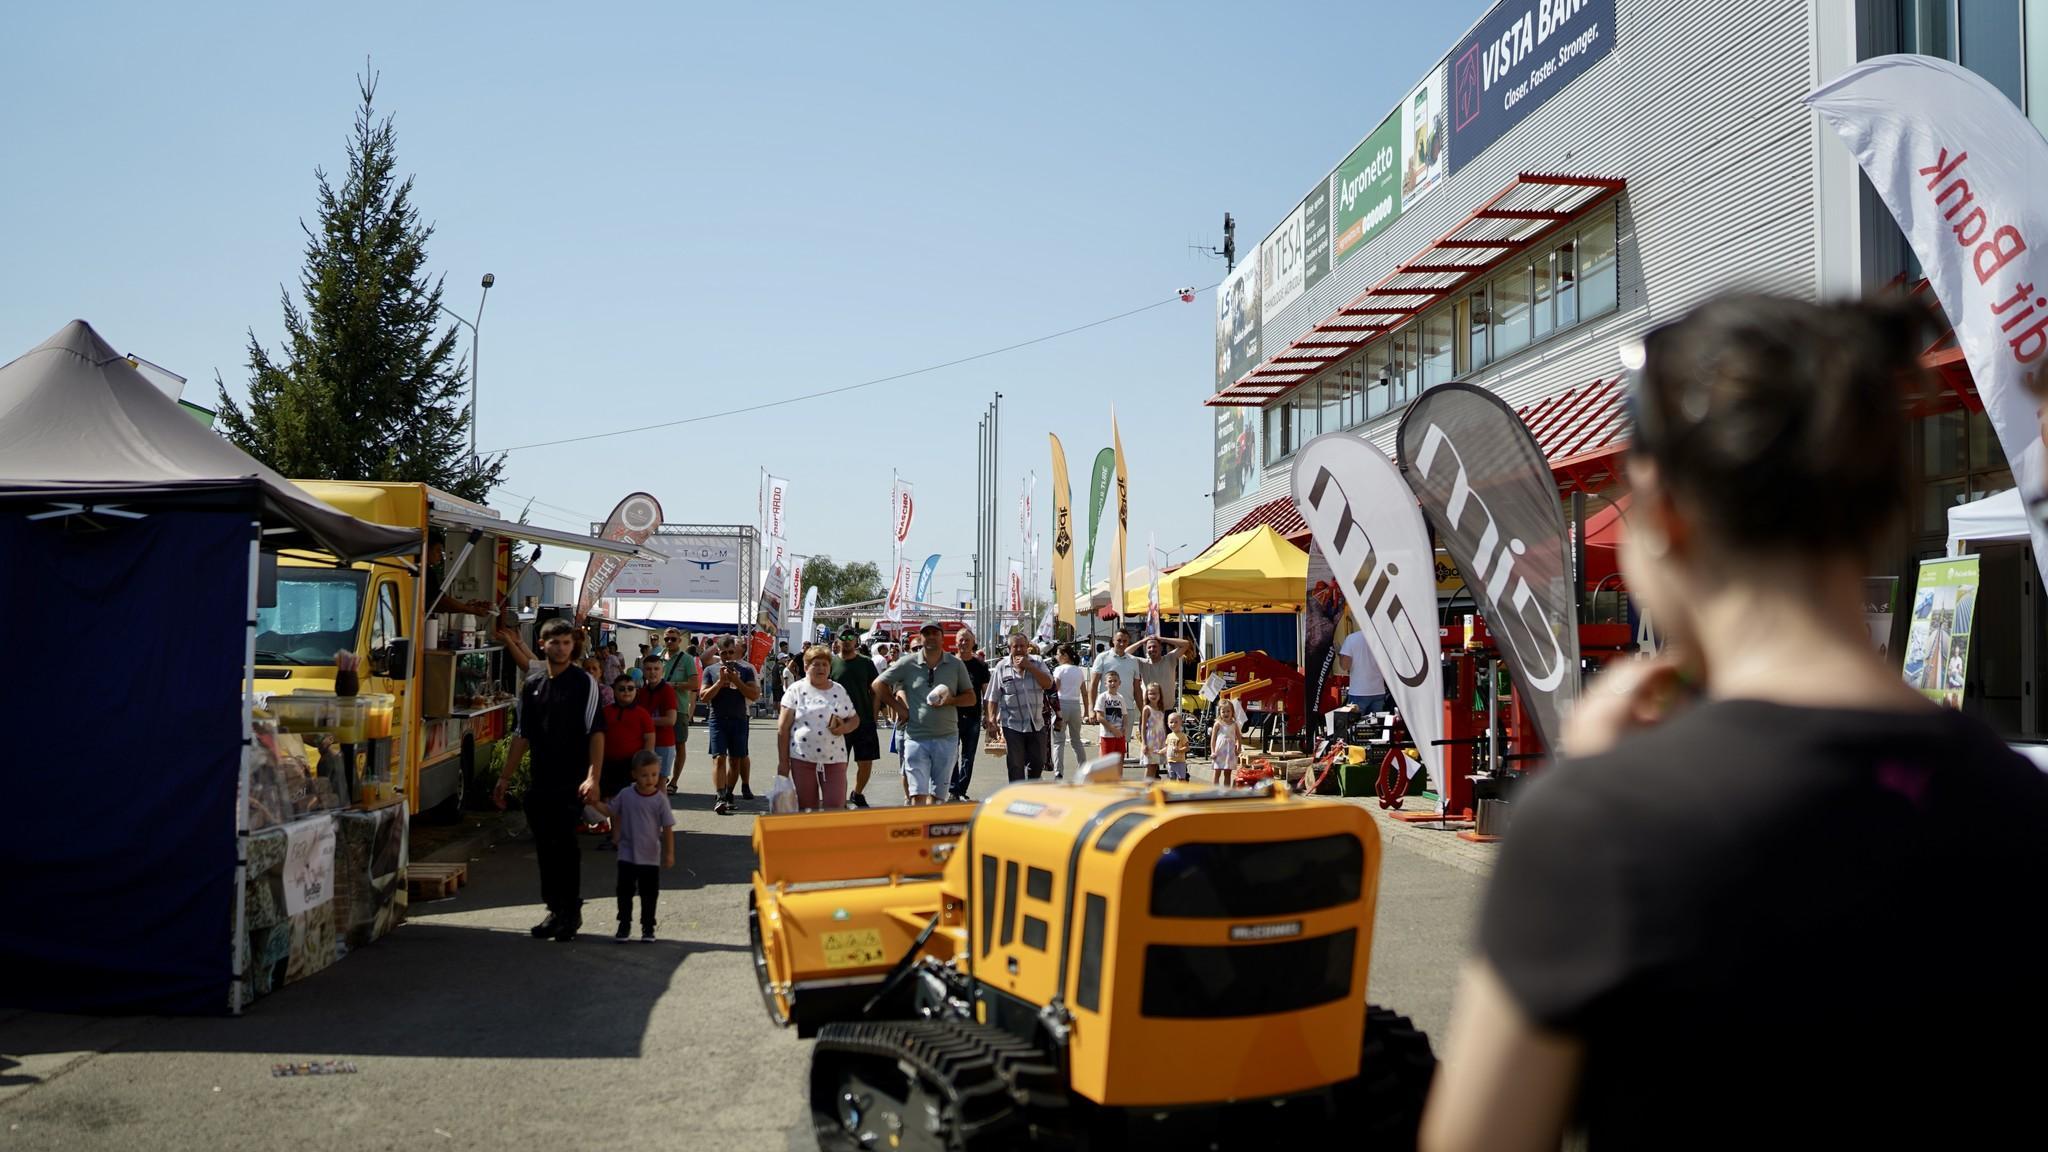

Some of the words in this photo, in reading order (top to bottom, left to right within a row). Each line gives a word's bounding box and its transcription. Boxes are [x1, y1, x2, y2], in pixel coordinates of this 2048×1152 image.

[1482, 10, 1533, 91] VISTA
[1504, 80, 1529, 111] Closer.
[1530, 57, 1557, 90] Faster.
[1558, 23, 1599, 67] Stronger.
[1339, 145, 1393, 212] Agronetto
[1275, 217, 1302, 281] TESA
[587, 558, 617, 593] COFFEE
